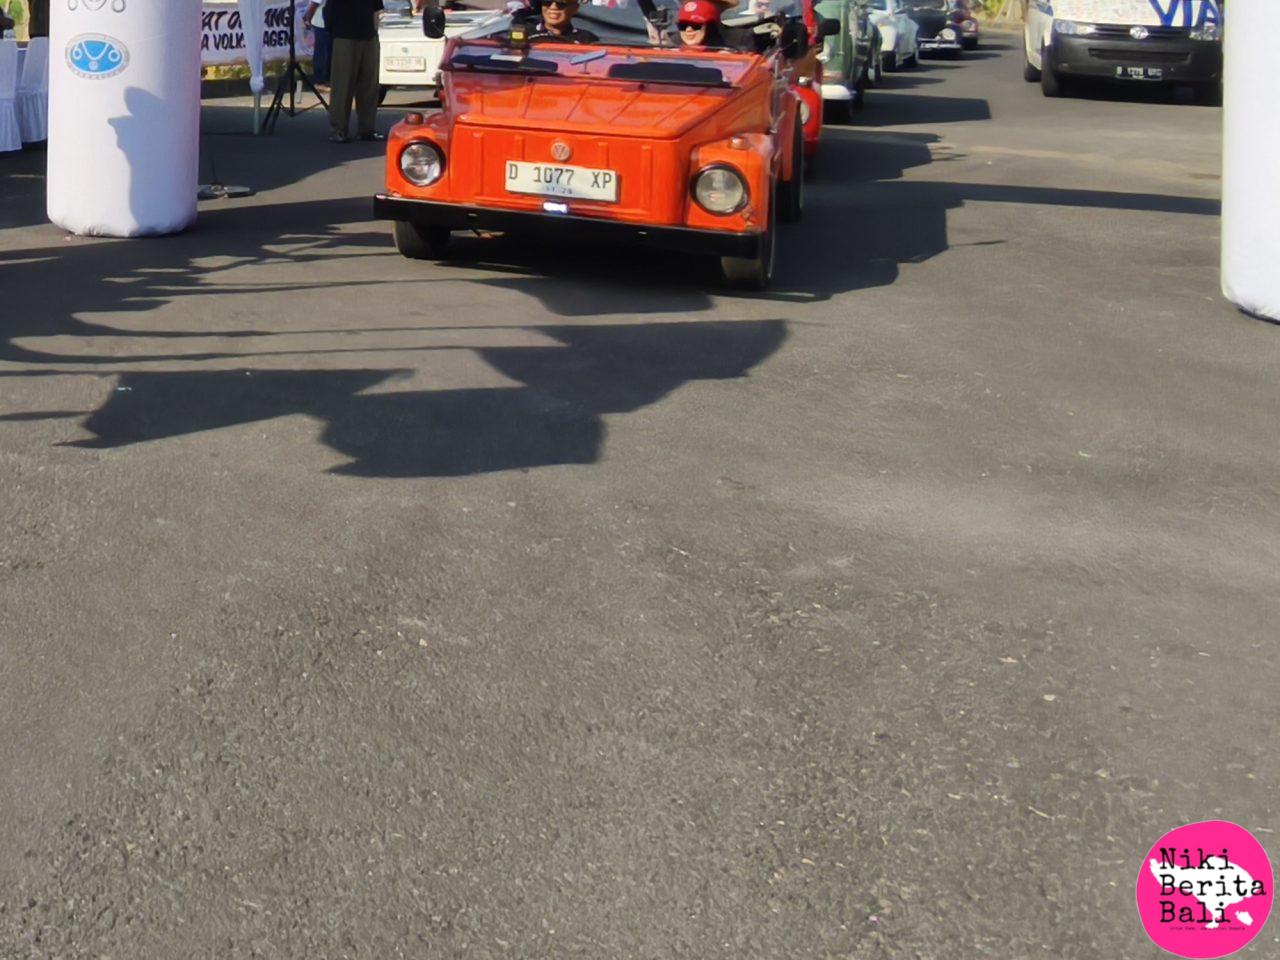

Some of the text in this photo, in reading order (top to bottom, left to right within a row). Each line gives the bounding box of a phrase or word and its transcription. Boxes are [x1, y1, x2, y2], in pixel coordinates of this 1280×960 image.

[508, 163, 612, 189] D 1077 XP
